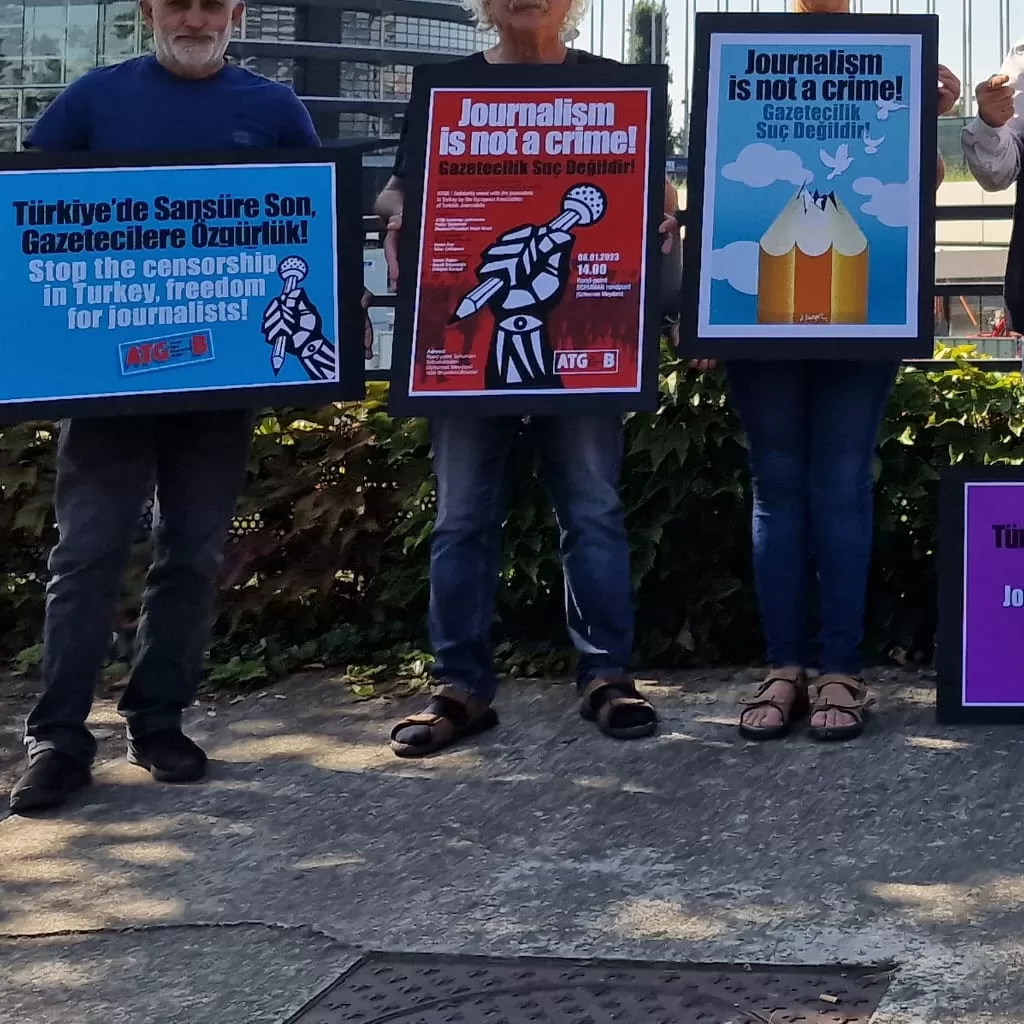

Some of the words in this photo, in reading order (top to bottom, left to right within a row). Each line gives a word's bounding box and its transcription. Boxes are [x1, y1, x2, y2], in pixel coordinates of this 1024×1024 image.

[745, 49, 883, 75] Journalism
[728, 75, 751, 101] is
[756, 76, 797, 101] not
[801, 79, 817, 101] a
[822, 75, 903, 101] crime!
[458, 98, 616, 127] Journalism
[763, 103, 861, 121] Gazetecilik
[439, 126, 466, 156] is
[470, 128, 518, 156] not
[522, 131, 540, 156] a
[545, 126, 638, 155] crime!
[756, 122, 789, 142] Suç
[438, 160, 529, 176] Gazetecilik
[12, 197, 149, 227] Türkiye'de
[153, 193, 259, 222] Sansüre
[264, 192, 316, 219] Son,
[22, 225, 186, 255] Gazetecilere
[192, 217, 309, 250] Özgürlük!
[28, 259, 87, 283] Stop
[94, 256, 136, 280] the
[143, 252, 277, 278] censorship
[577, 263, 607, 276] 14.00
[43, 285, 67, 307] in
[73, 281, 160, 305] Turkey,
[166, 277, 266, 302] freedom
[67, 308, 102, 330] for
[108, 299, 249, 330] journalists!
